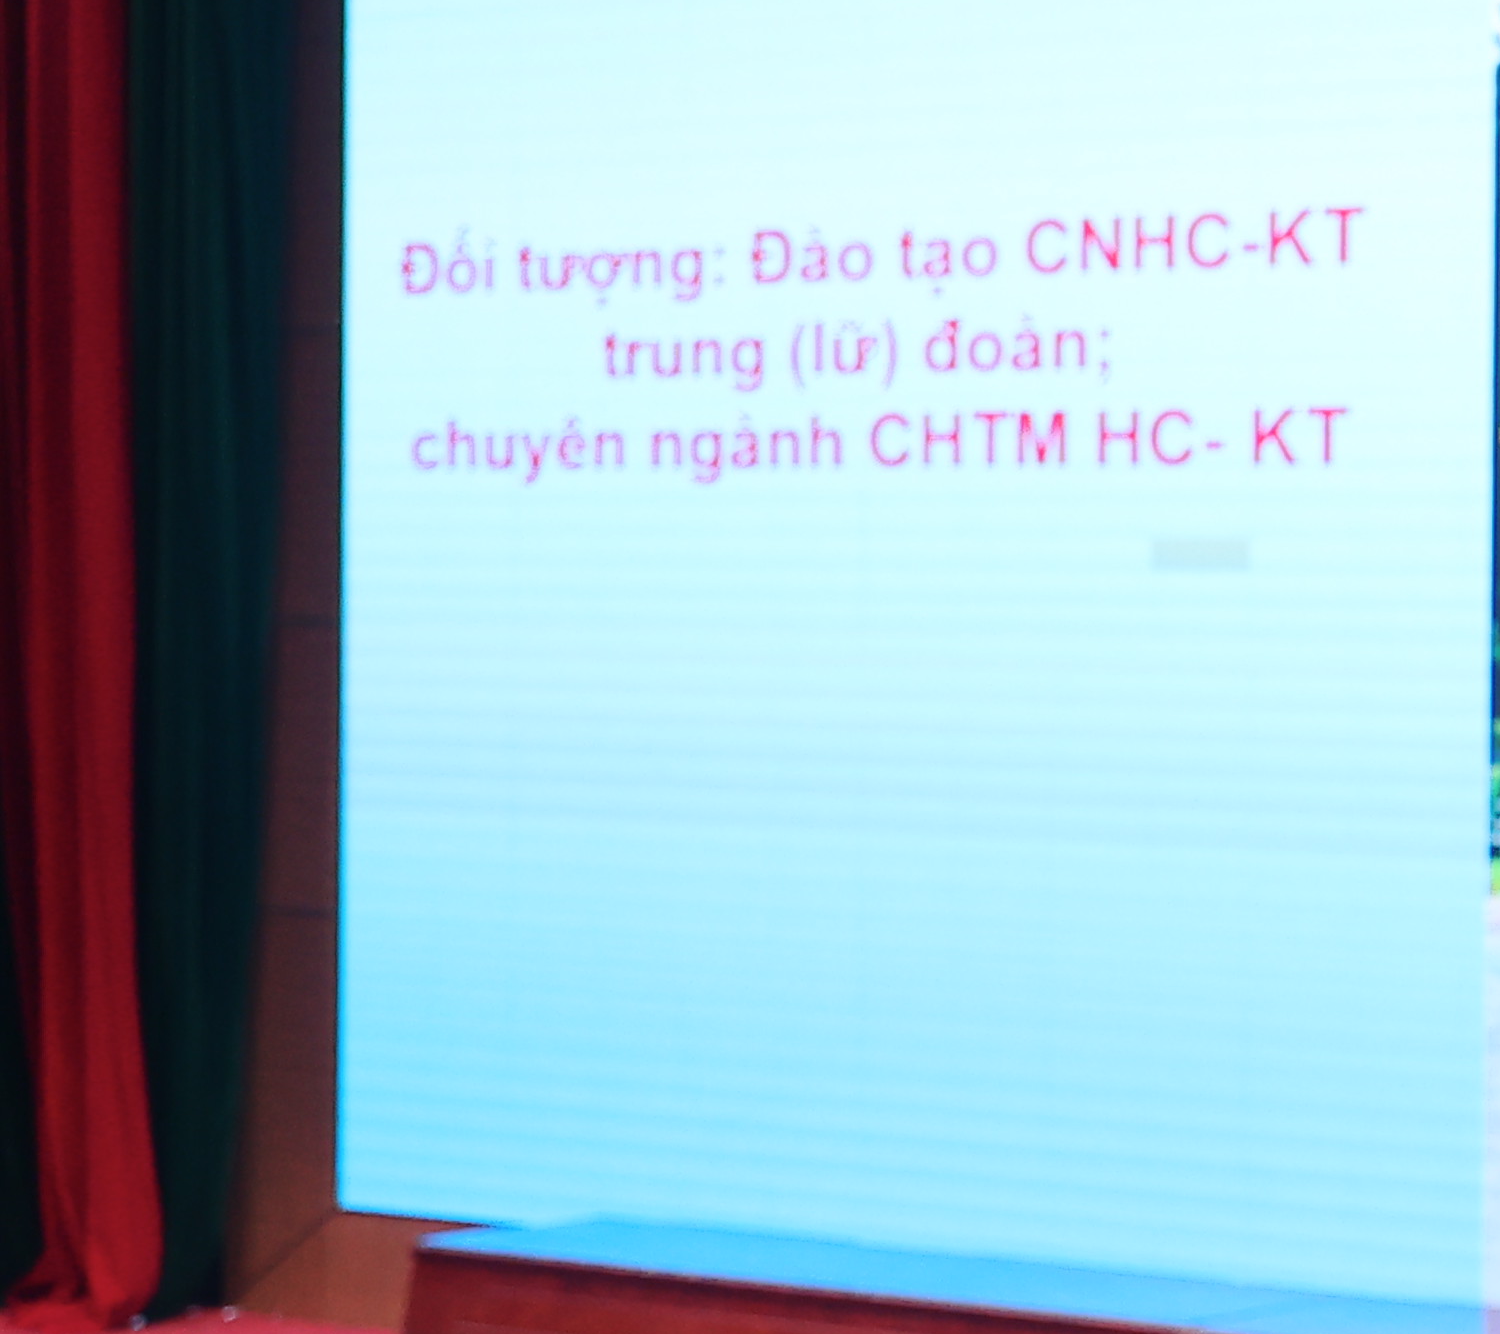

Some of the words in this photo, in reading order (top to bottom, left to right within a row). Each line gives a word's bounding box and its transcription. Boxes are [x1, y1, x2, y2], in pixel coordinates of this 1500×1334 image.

[400, 225, 495, 296] Đối
[516, 245, 725, 307] tượng:
[747, 225, 876, 286] Đào
[898, 229, 1000, 296] tạo
[1024, 205, 1366, 276] CNHC-KT
[602, 332, 766, 393] trung
[789, 319, 899, 389] (lữ)
[922, 313, 1112, 385] đoàn;
[410, 415, 627, 486] chuyên
[648, 411, 845, 486] ngành
[868, 408, 1070, 469] CHTM
[1096, 407, 1226, 468] HC-
[1250, 405, 1351, 467] KT
